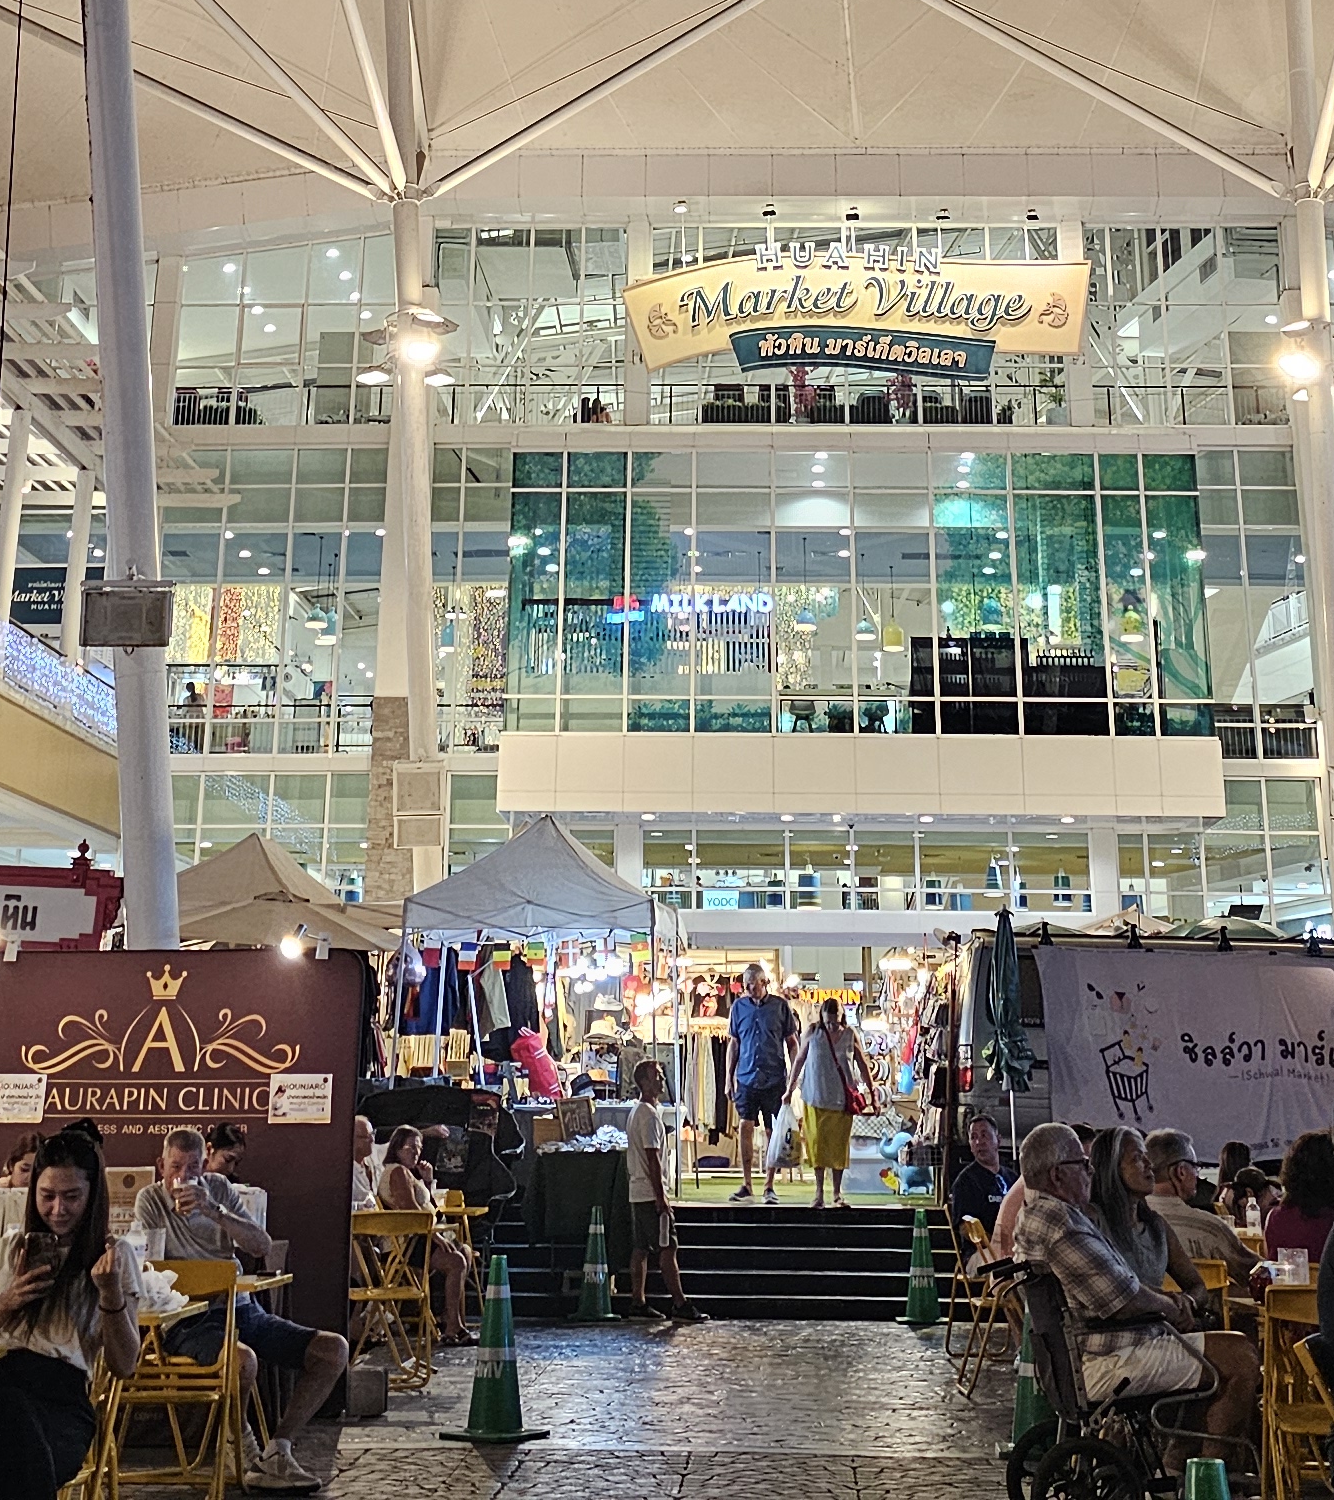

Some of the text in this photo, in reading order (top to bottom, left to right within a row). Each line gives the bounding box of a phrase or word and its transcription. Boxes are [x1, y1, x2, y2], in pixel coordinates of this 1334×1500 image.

[755, 242, 943, 274] HUA HIN
[679, 274, 1033, 332] Market Village
[759, 333, 967, 368] หัวหิน มาร์เก็ตวิลเลจ
[131, 1006, 185, 1073] A
[44, 1086, 269, 1112] AURAPIN CLINIC
[122, 1124, 143, 1134] AND
